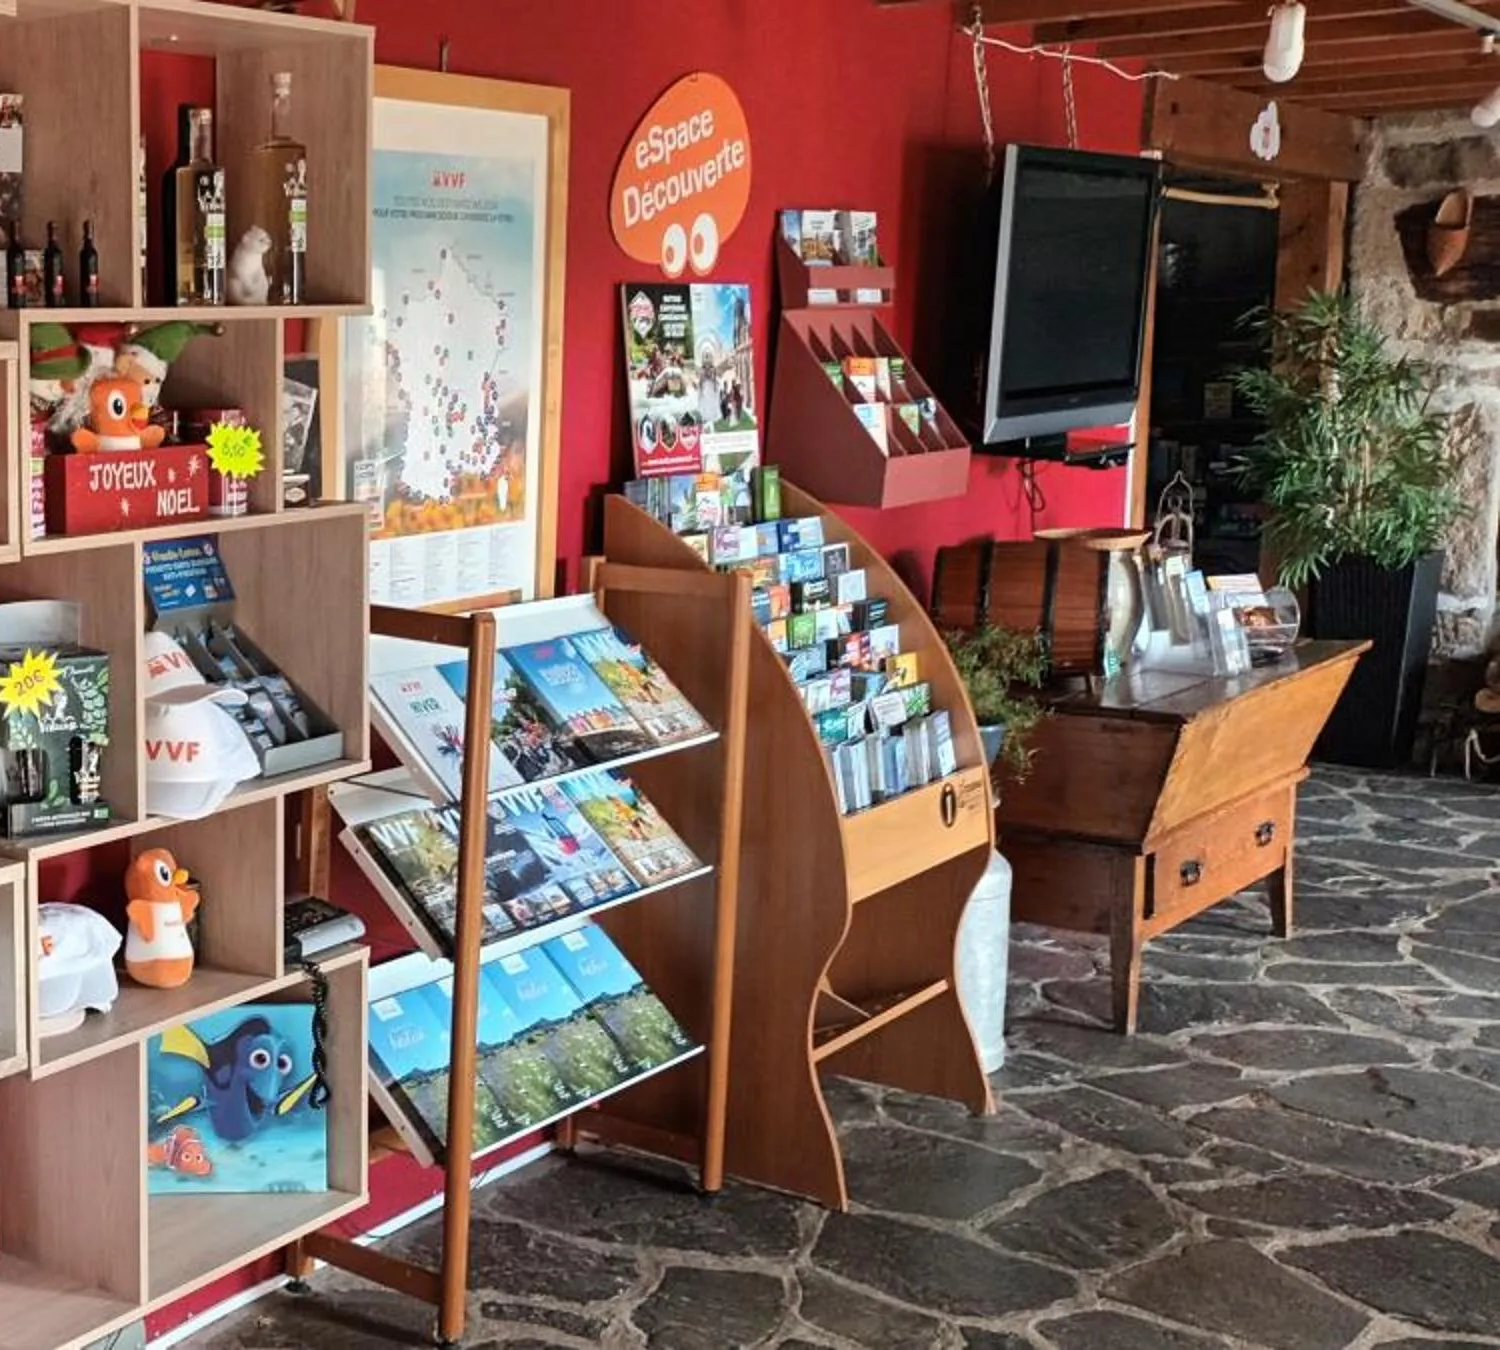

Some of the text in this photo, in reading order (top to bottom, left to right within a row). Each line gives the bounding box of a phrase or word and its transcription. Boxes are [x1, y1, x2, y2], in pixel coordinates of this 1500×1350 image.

[635, 109, 715, 170] eSpace
[622, 139, 746, 230] Découverte
[88, 460, 157, 492] JOYEUX
[13, 668, 46, 697] 20€
[145, 739, 200, 762] VVF
